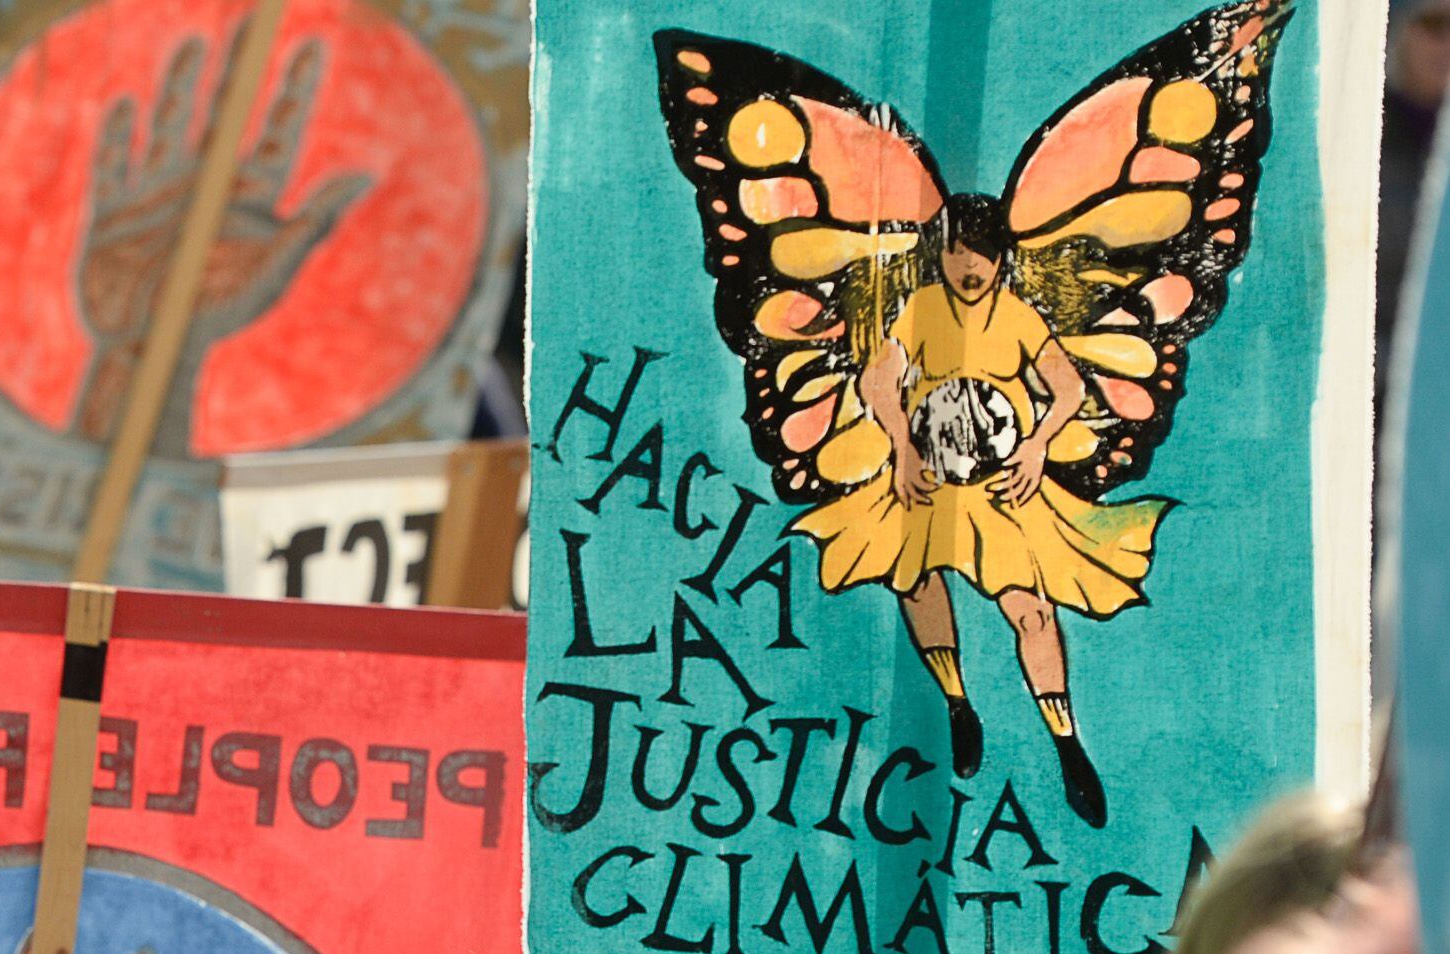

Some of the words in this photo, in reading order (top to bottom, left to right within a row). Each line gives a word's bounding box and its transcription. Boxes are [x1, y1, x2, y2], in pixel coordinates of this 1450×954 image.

[531, 345, 809, 650] HACIA
[557, 528, 776, 718] LA
[528, 679, 1059, 877] JUSTICIA
